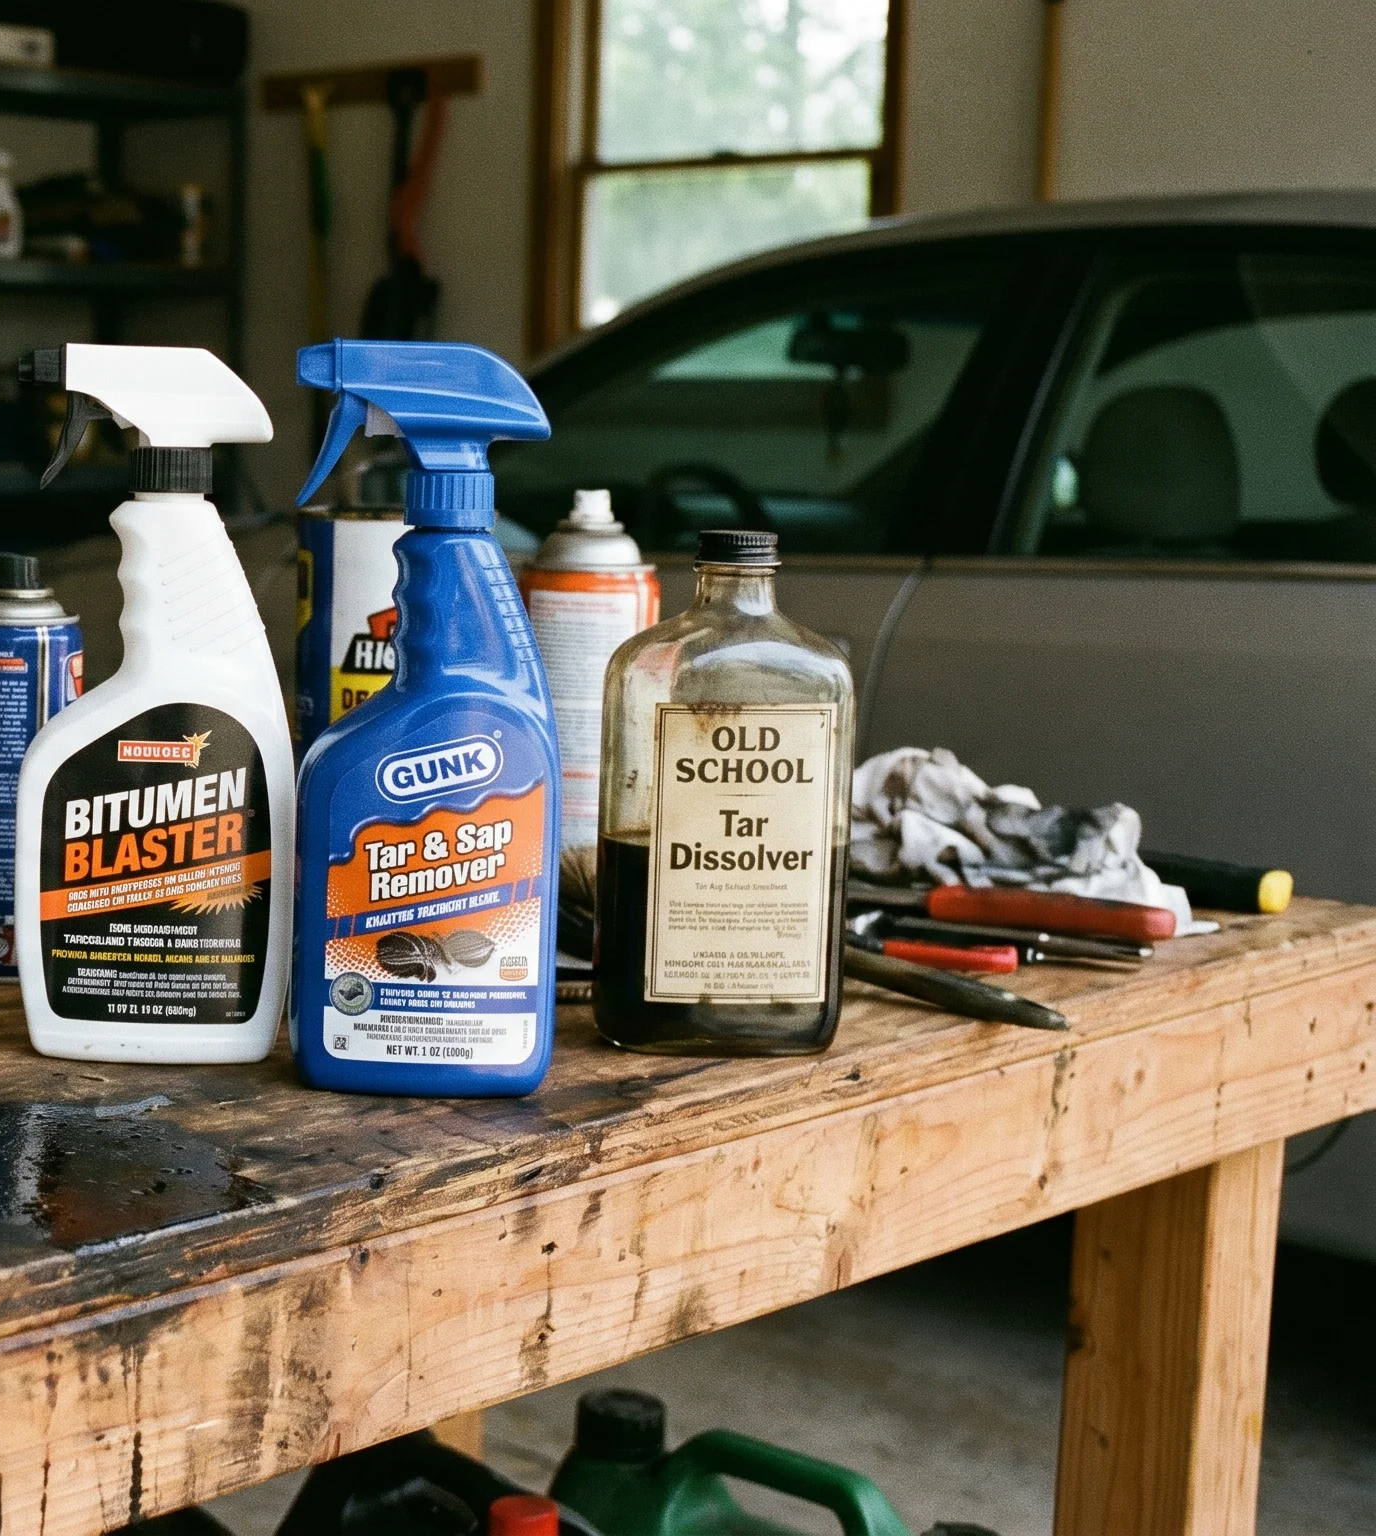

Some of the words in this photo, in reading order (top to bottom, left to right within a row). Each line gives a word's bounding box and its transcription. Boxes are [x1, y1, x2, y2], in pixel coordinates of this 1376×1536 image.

[711, 726, 781, 752] OLD
[391, 748, 487, 789] GUNK
[676, 758, 814, 784] SCHOOL
[65, 767, 247, 840] BITUMEN
[719, 810, 769, 838] Tar
[64, 812, 244, 882] BLASTER
[366, 841, 415, 871] Tar
[423, 831, 449, 860] &
[456, 820, 512, 855] Sap
[669, 842, 813, 871] Dissolver
[370, 852, 505, 901] Remover
[386, 1045, 402, 1055] NET
[404, 1046, 420, 1056] WT.
[422, 1047, 426, 1056] 1
[430, 1047, 440, 1057] OZ
